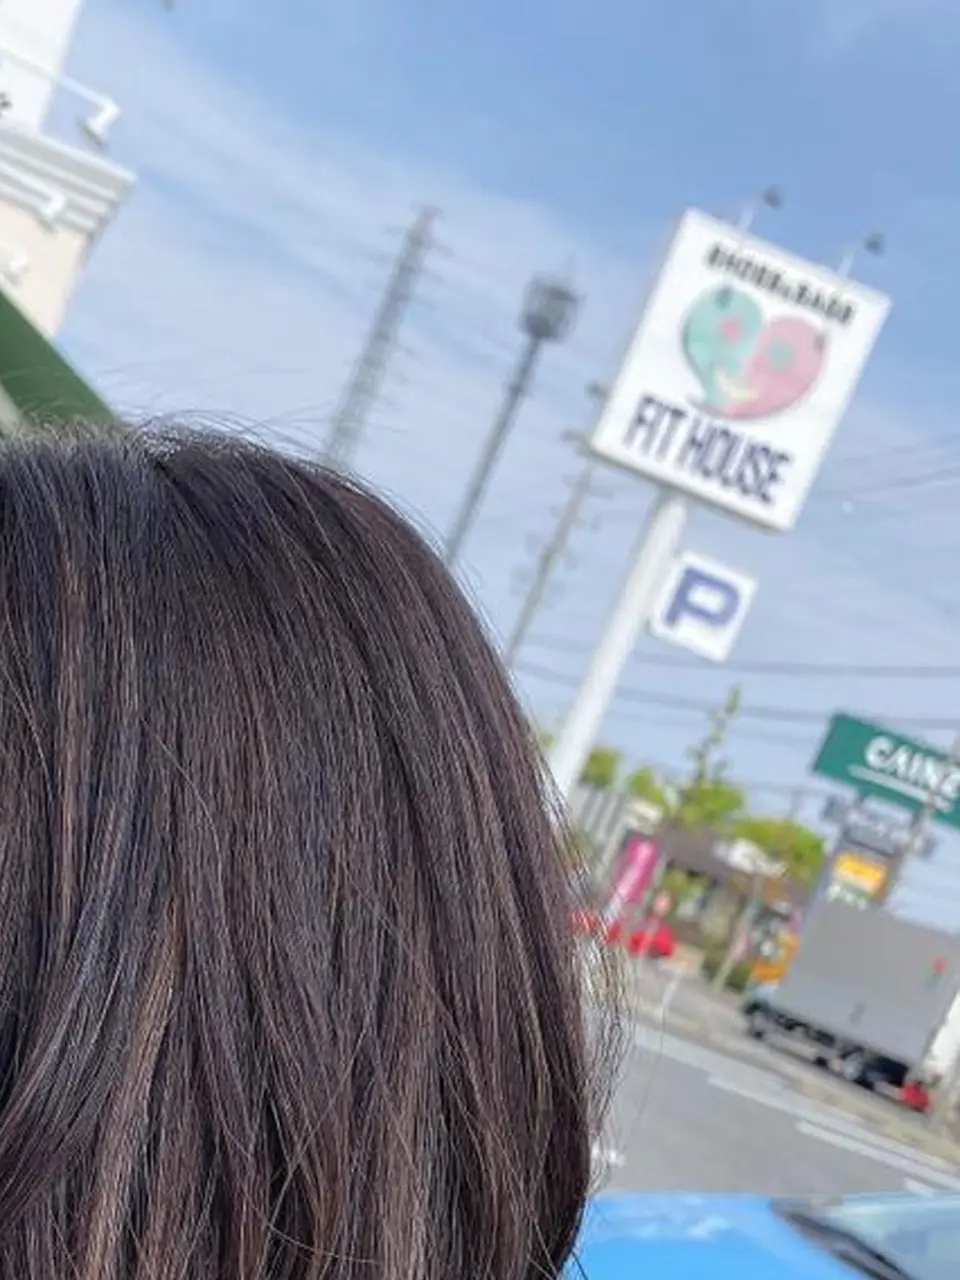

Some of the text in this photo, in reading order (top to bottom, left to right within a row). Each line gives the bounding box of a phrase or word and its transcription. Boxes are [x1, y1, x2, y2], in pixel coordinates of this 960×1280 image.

[623, 395, 791, 504] FIT HOUSE
[663, 566, 740, 626] P
